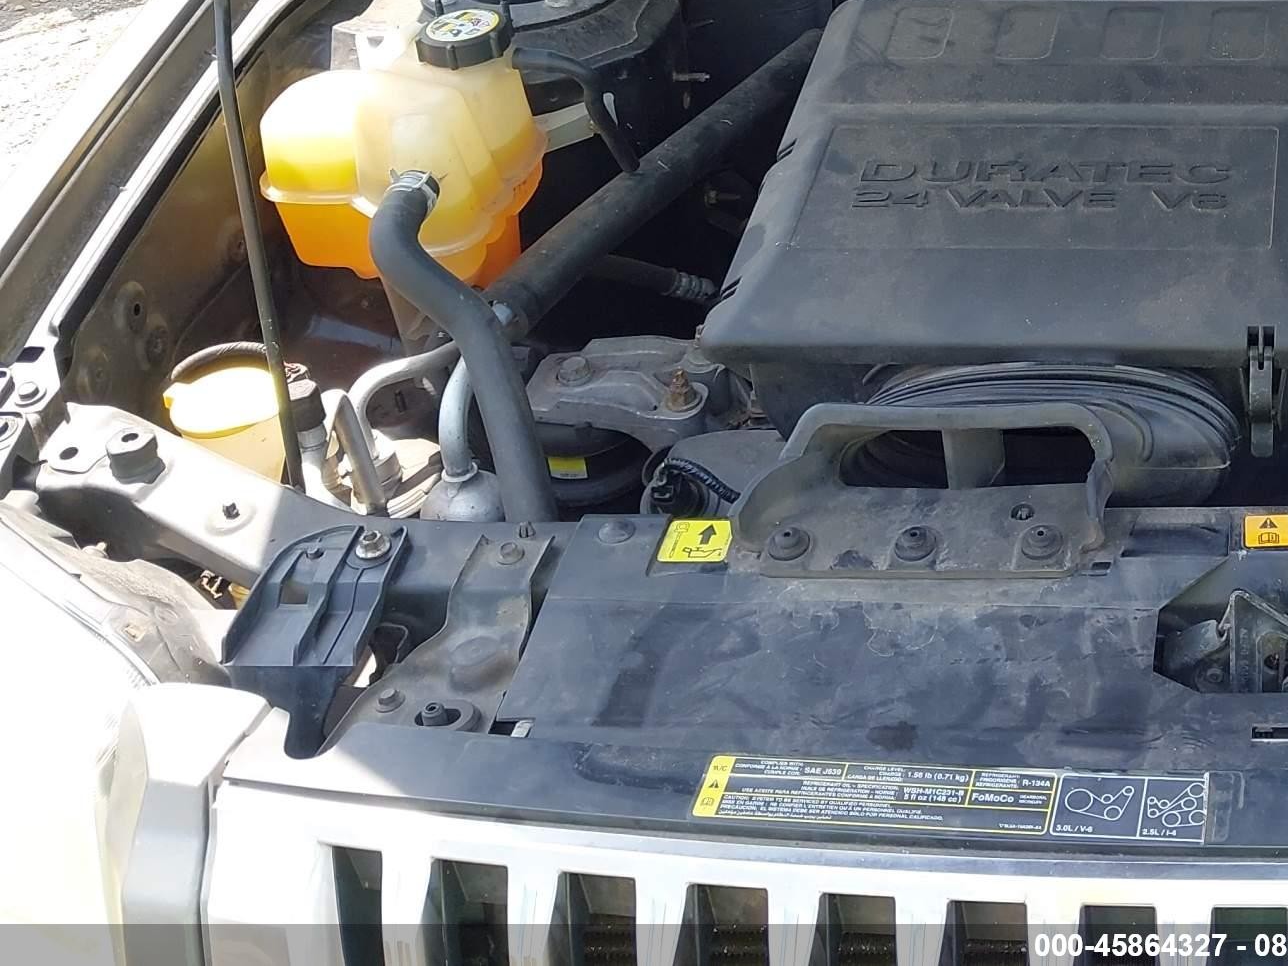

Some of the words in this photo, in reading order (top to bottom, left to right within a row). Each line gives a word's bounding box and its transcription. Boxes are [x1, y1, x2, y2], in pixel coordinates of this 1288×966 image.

[859, 160, 1231, 184] DURATEC
[852, 188, 929, 209] 24
[947, 188, 1117, 210] VALVE
[1151, 188, 1229, 211] V6
[955, 773, 969, 782] kg)
[1022, 779, 1051, 787] R-134A
[971, 793, 1015, 803] FoMoCo
